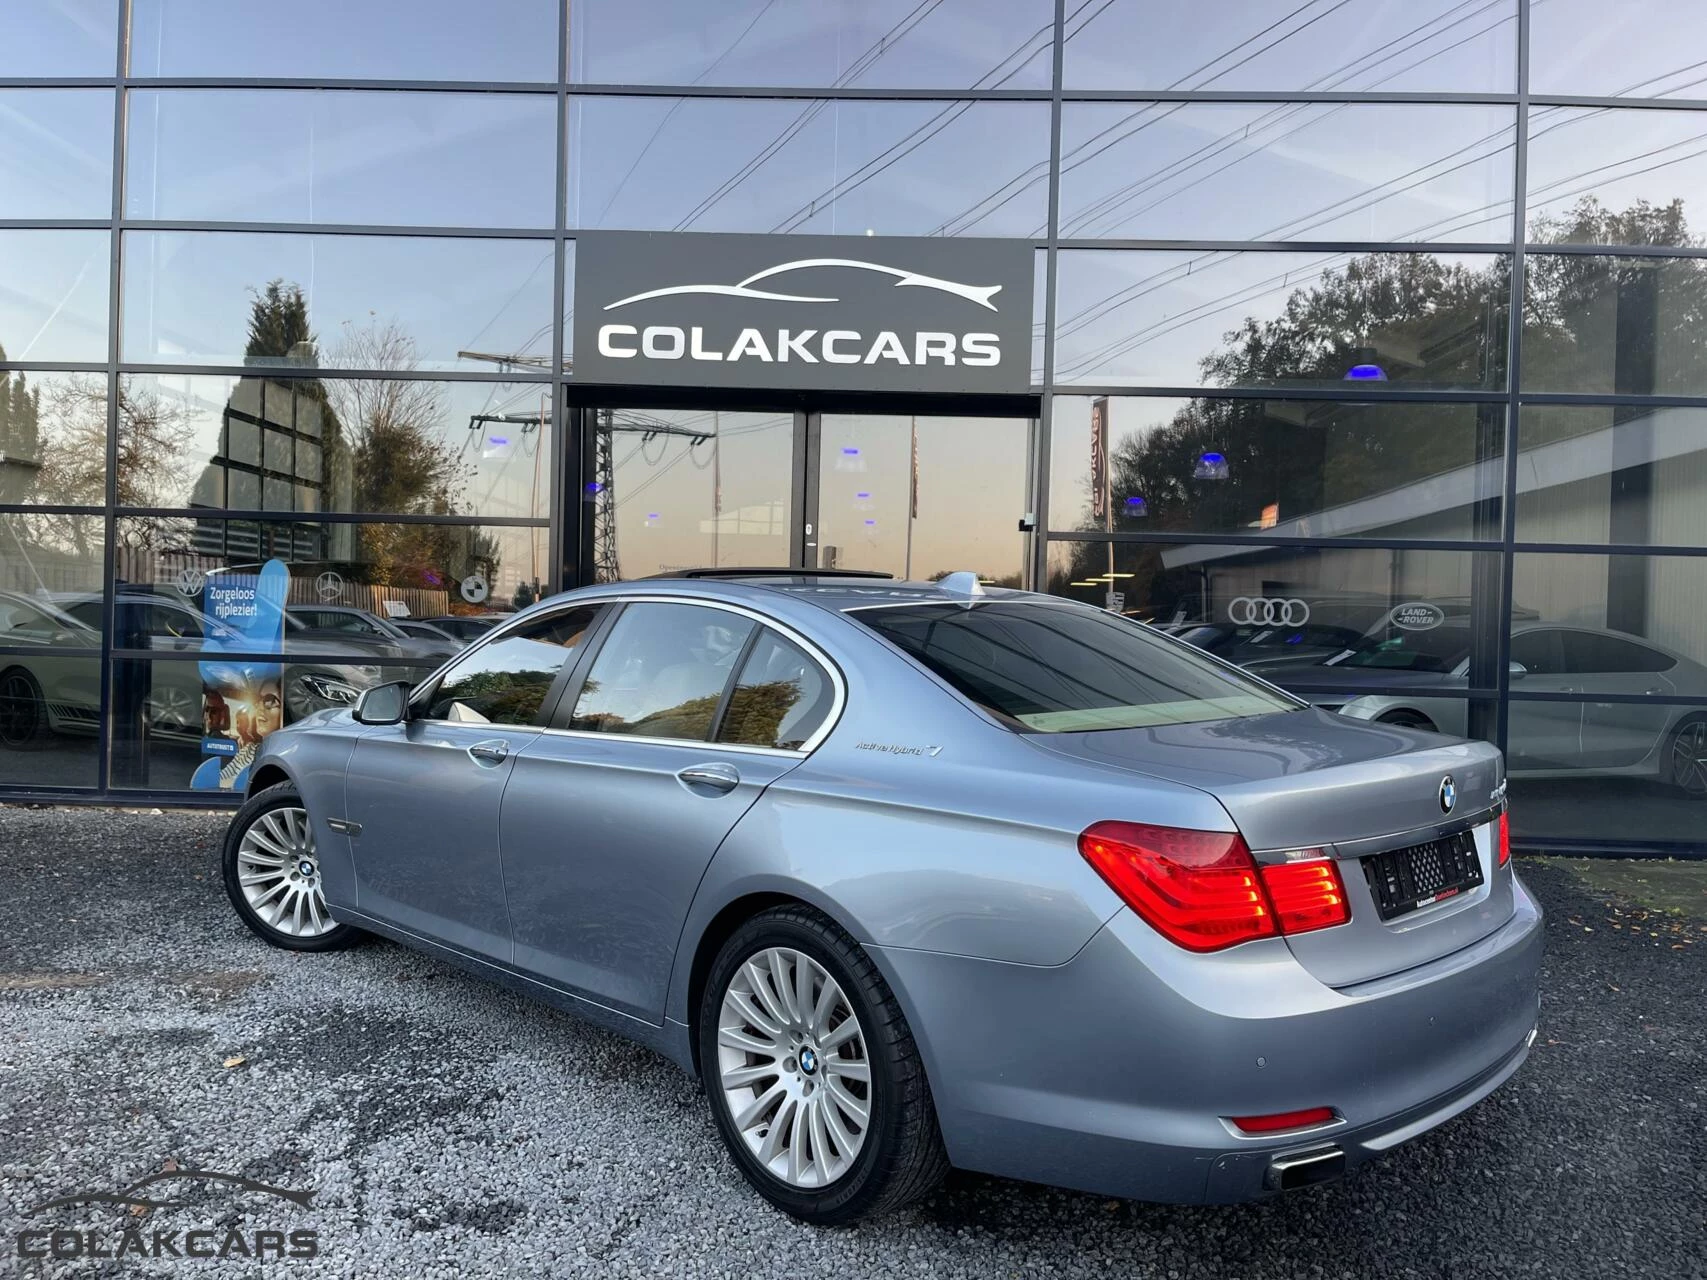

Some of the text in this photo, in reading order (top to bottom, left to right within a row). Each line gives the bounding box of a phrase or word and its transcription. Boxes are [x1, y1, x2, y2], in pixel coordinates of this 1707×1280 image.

[598, 324, 1002, 367] COLAKCARS
[210, 586, 255, 603] Zorgeloos
[215, 603, 257, 619] rijplezier!
[925, 745, 944, 757] 7
